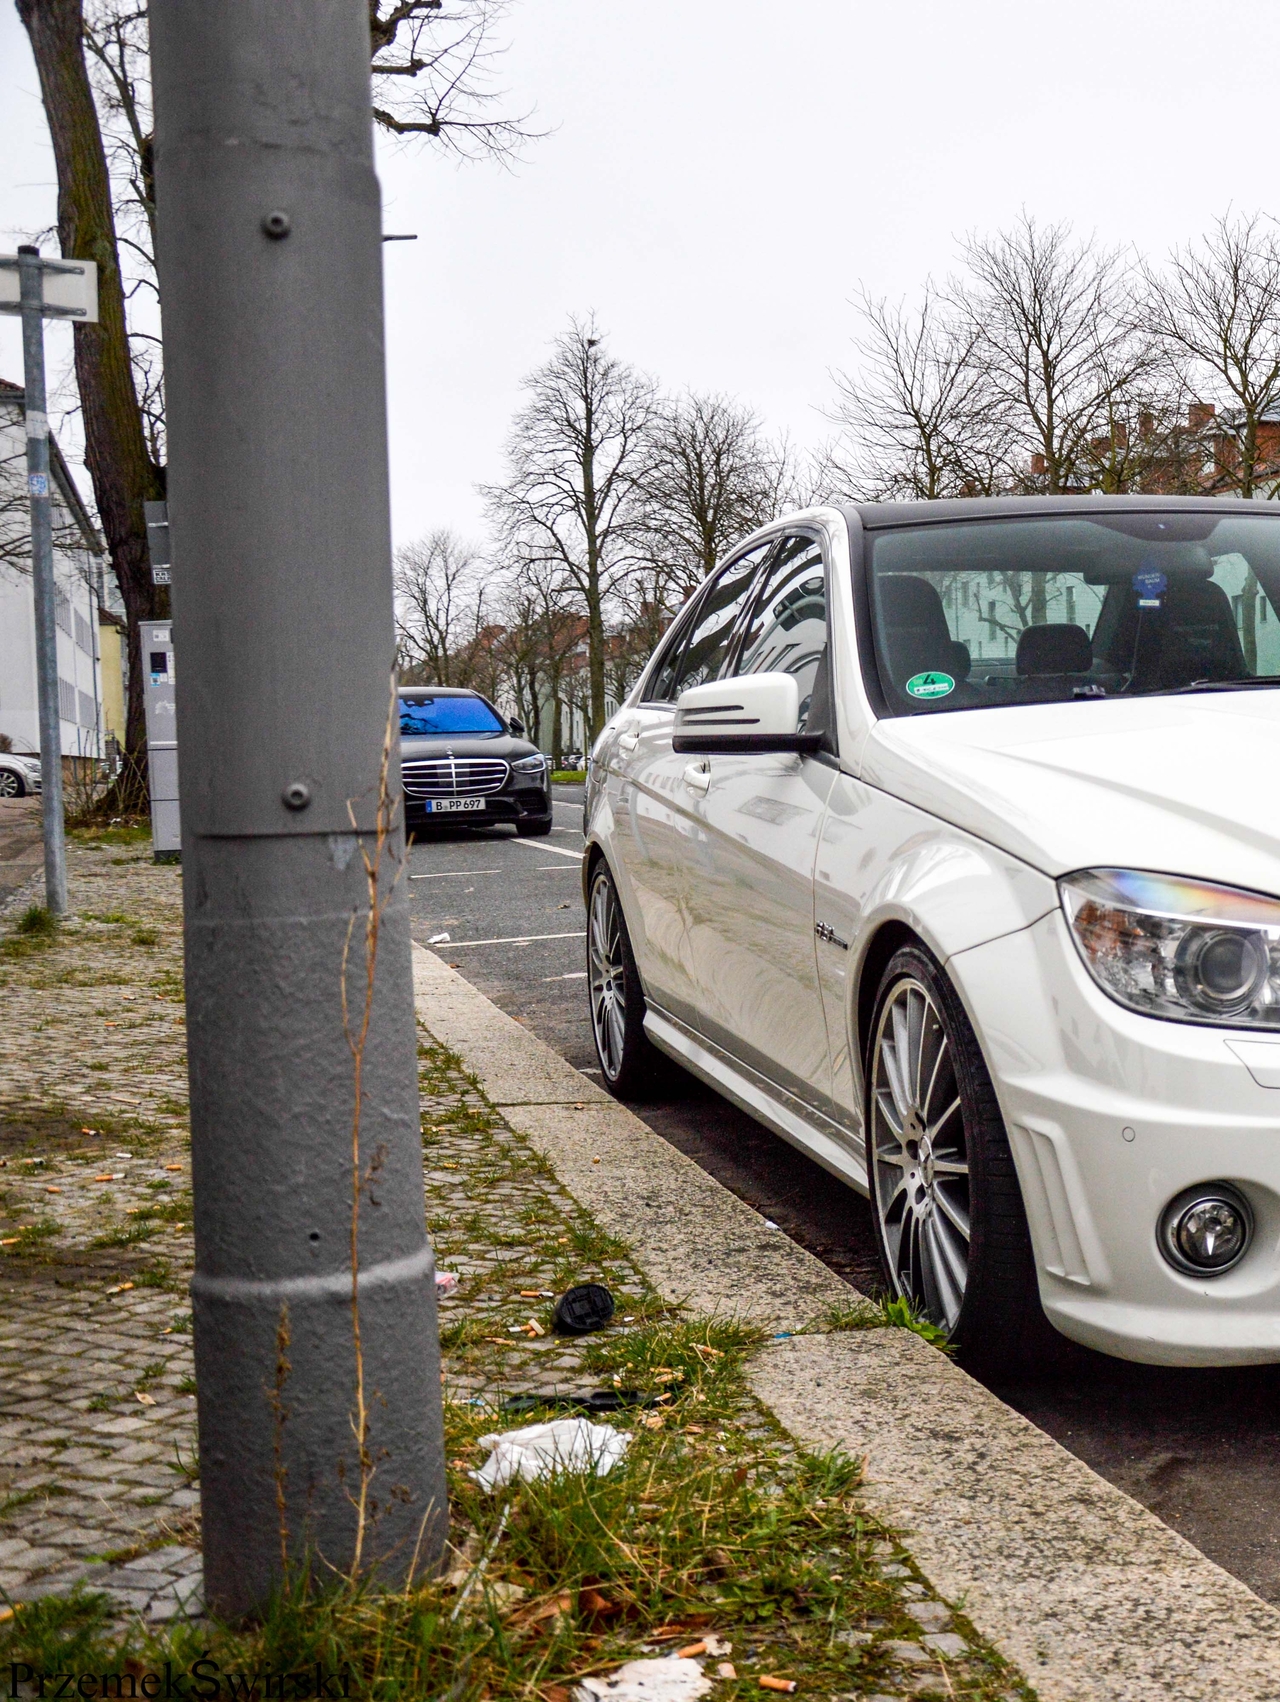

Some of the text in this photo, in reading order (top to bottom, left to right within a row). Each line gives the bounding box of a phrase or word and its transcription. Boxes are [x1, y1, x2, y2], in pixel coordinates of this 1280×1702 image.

[436, 802, 443, 810] B
[449, 801, 461, 810] PP
[463, 799, 481, 809] 697
